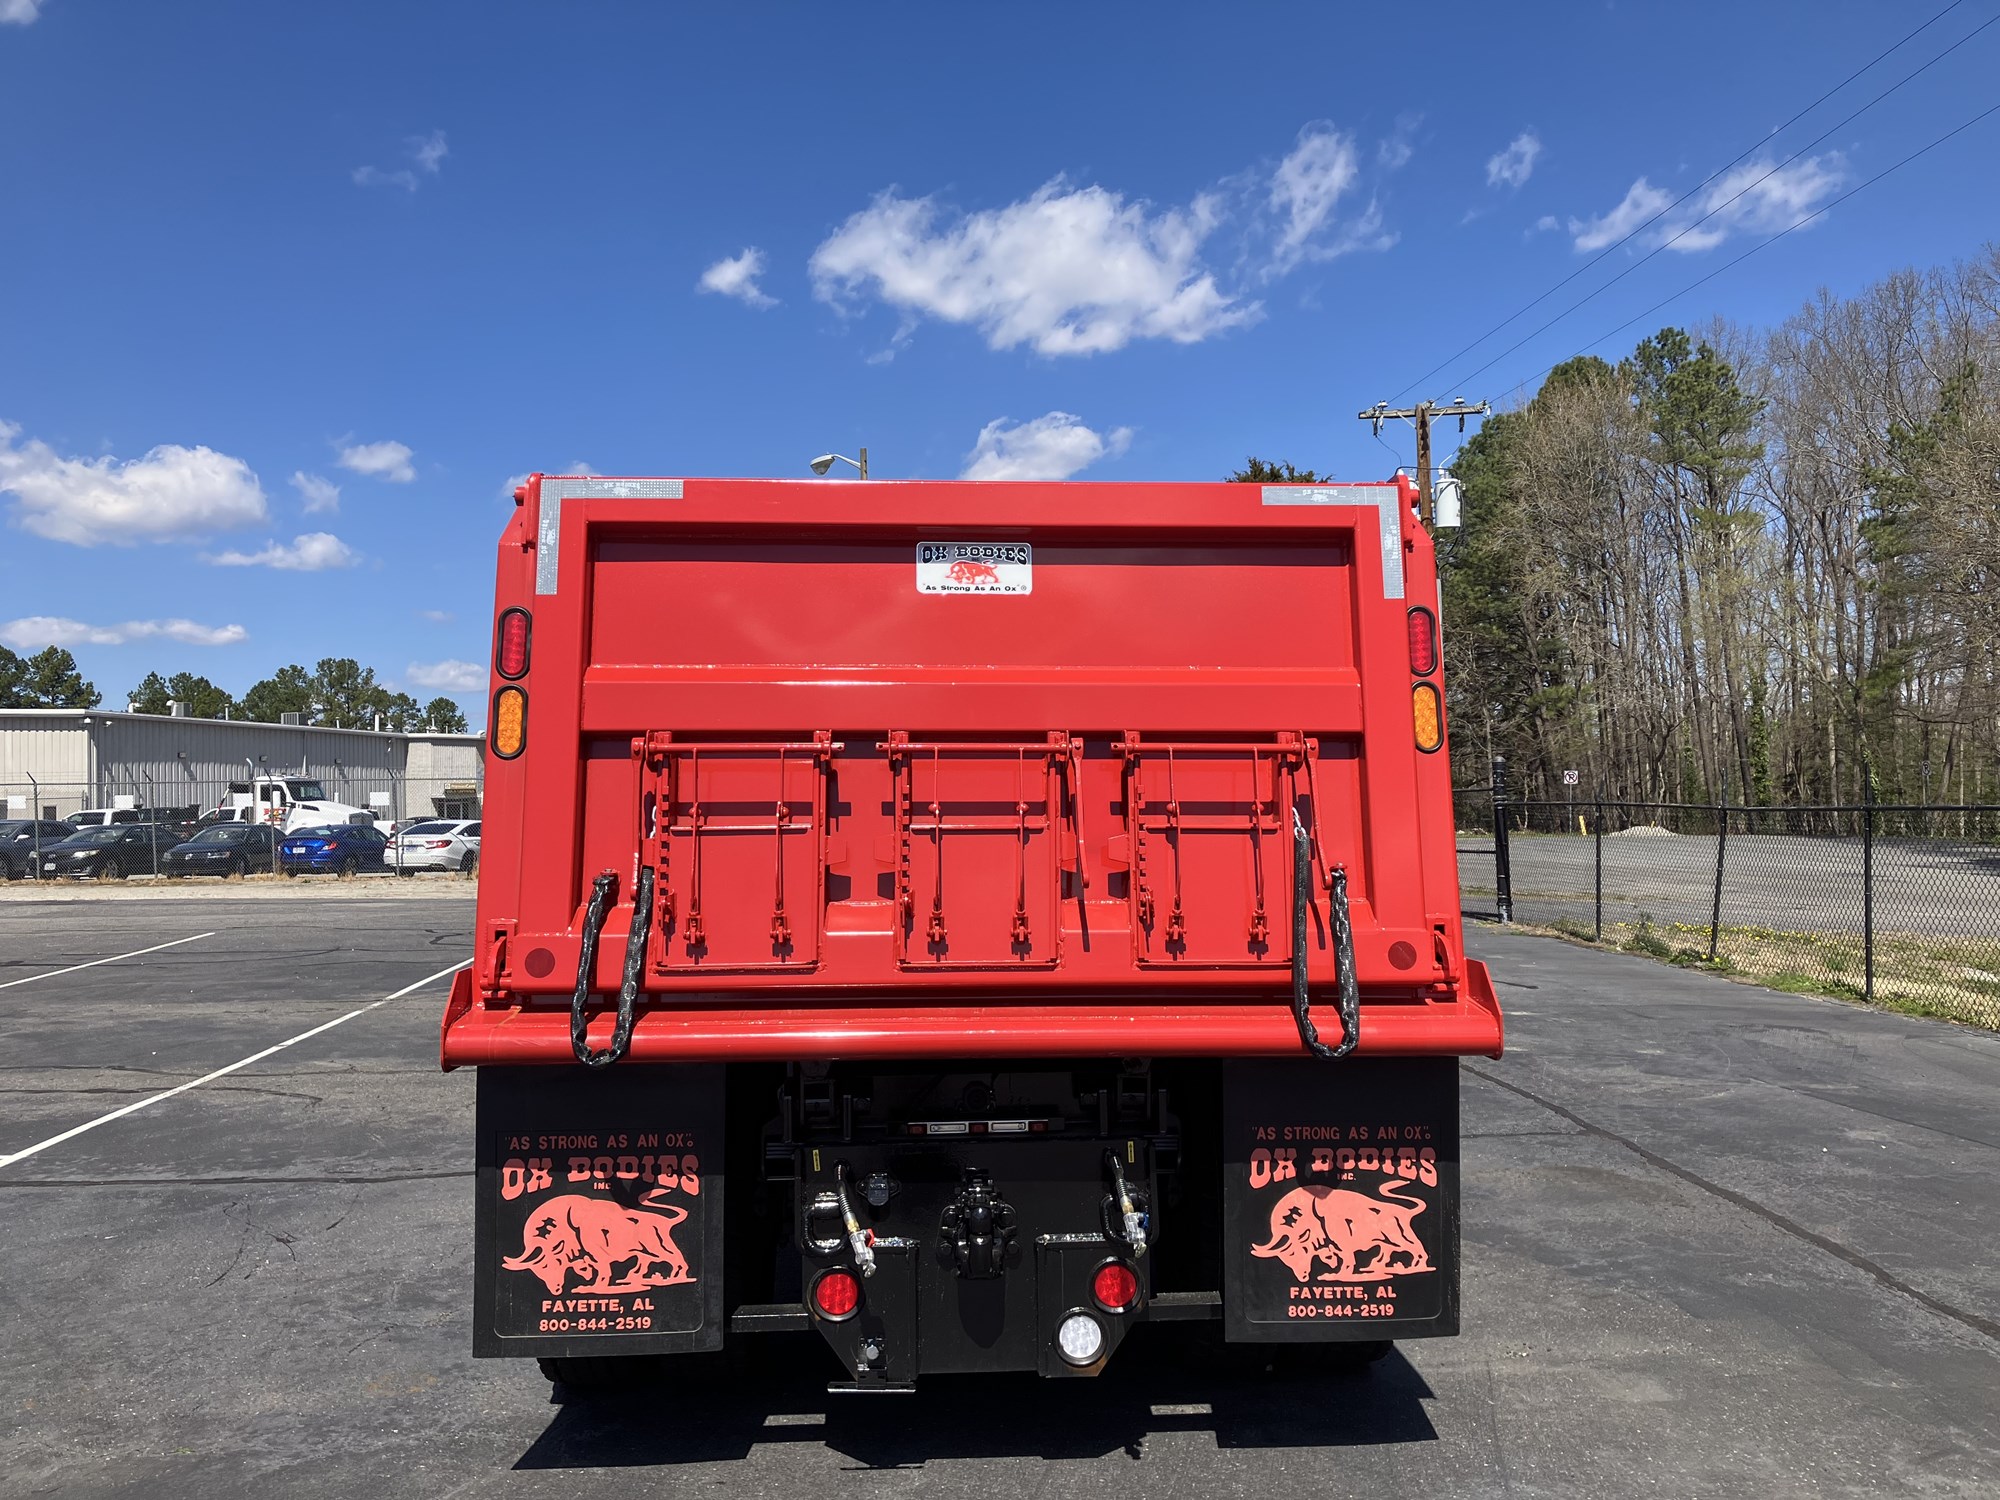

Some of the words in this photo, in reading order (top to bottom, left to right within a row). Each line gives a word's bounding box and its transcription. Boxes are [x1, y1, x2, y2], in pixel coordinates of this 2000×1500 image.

[921, 545, 949, 564] OX
[955, 545, 1028, 566] BODIES
[538, 1134, 598, 1150] STRONG
[606, 1134, 629, 1149] AS
[637, 1133, 659, 1148] AN
[1283, 1126, 1340, 1141] STRONG
[1348, 1126, 1369, 1140] AS
[1377, 1126, 1398, 1140] AN
[1249, 1147, 1298, 1190] OX
[1311, 1146, 1438, 1188] BODIES
[501, 1157, 553, 1201] OX
[566, 1154, 701, 1197] BODIES
[1289, 1286, 1369, 1301] FAYETTE,
[1375, 1285, 1397, 1299] AL
[541, 1298, 625, 1314] FAYETTE,
[632, 1297, 655, 1311] AL
[1288, 1303, 1394, 1318] 800-844-2519
[539, 1316, 652, 1332] 800-844-2519
